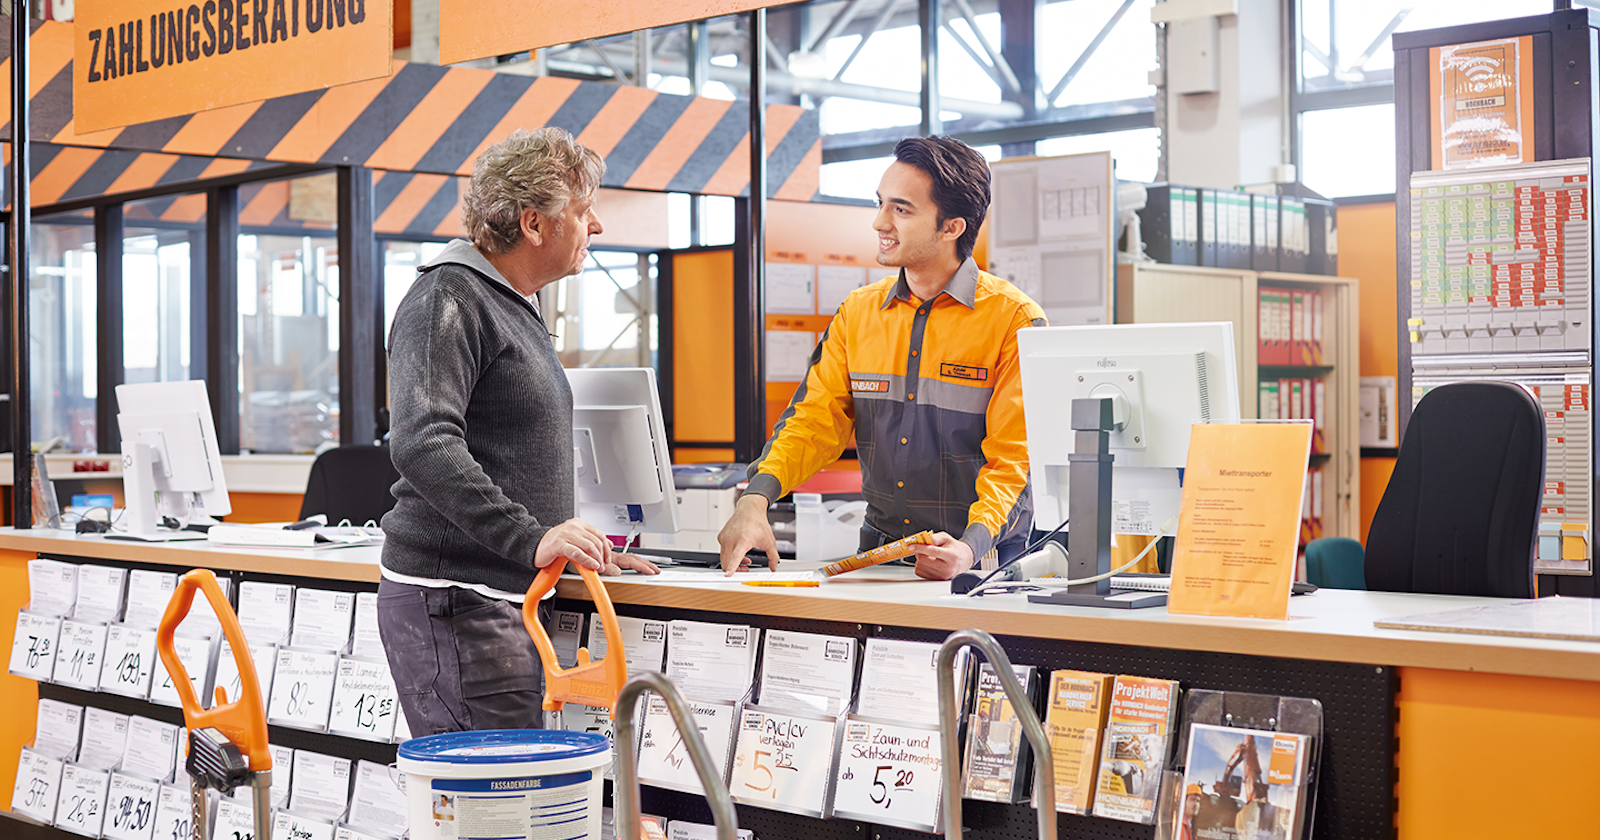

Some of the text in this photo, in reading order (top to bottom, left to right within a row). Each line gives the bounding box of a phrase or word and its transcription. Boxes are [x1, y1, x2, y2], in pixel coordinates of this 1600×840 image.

[87, 0, 366, 83] ZAHLUNGSBERATUNG
[1465, 98, 1496, 108] HORNBACH
[1096, 357, 1117, 369] FUJITSU
[851, 381, 879, 391] RNBACH
[1219, 469, 1273, 478] Miettransporter
[765, 718, 808, 740] PVC/CV
[851, 744, 942, 772] Sichtschutzmontage
[842, 767, 854, 780] ab
[490, 778, 542, 791] FASSADENFARBE
[1098, 793, 1145, 808] HORNBACH
